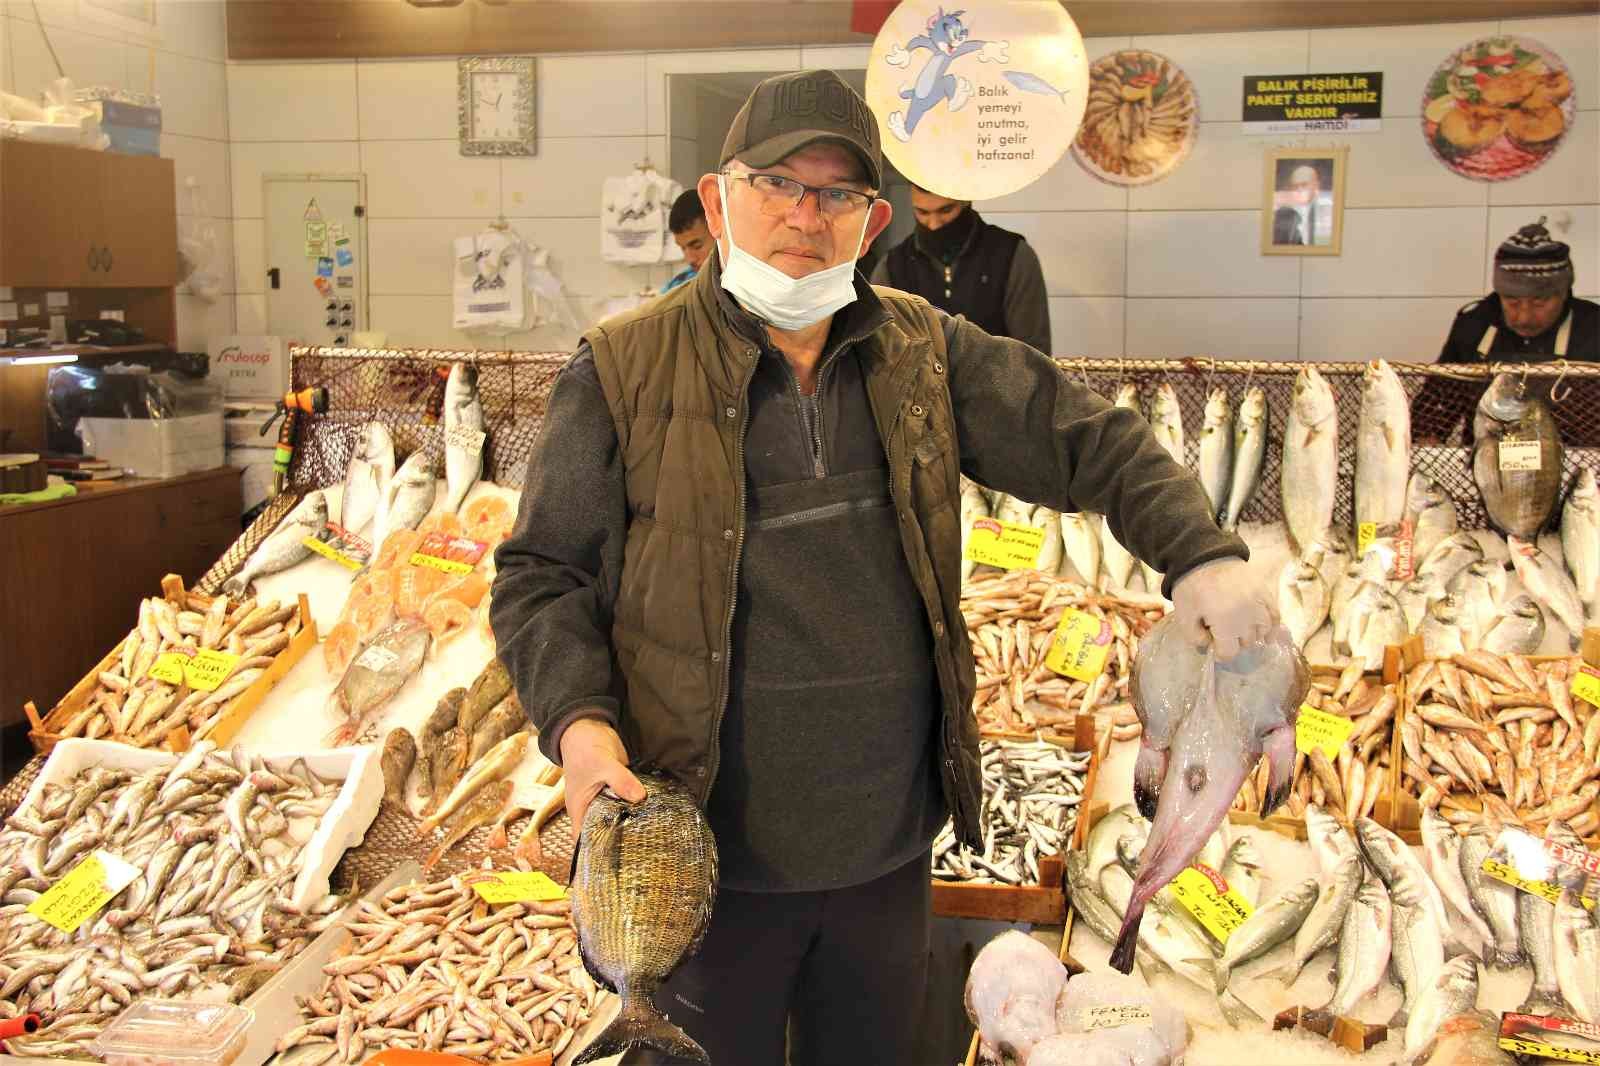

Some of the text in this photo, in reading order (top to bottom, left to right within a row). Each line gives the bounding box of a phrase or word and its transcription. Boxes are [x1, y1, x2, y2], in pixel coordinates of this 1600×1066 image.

[1256, 76, 1369, 92] BALIK PİŞİRİLİR
[978, 85, 1009, 97] Balık
[1247, 91, 1377, 106] PAKET SERVİSİMİZ
[976, 102, 1022, 115] yemeyi
[1284, 106, 1339, 119] VARDIR
[977, 119, 1030, 130] unutma,
[976, 133, 1028, 147] iyi gelir
